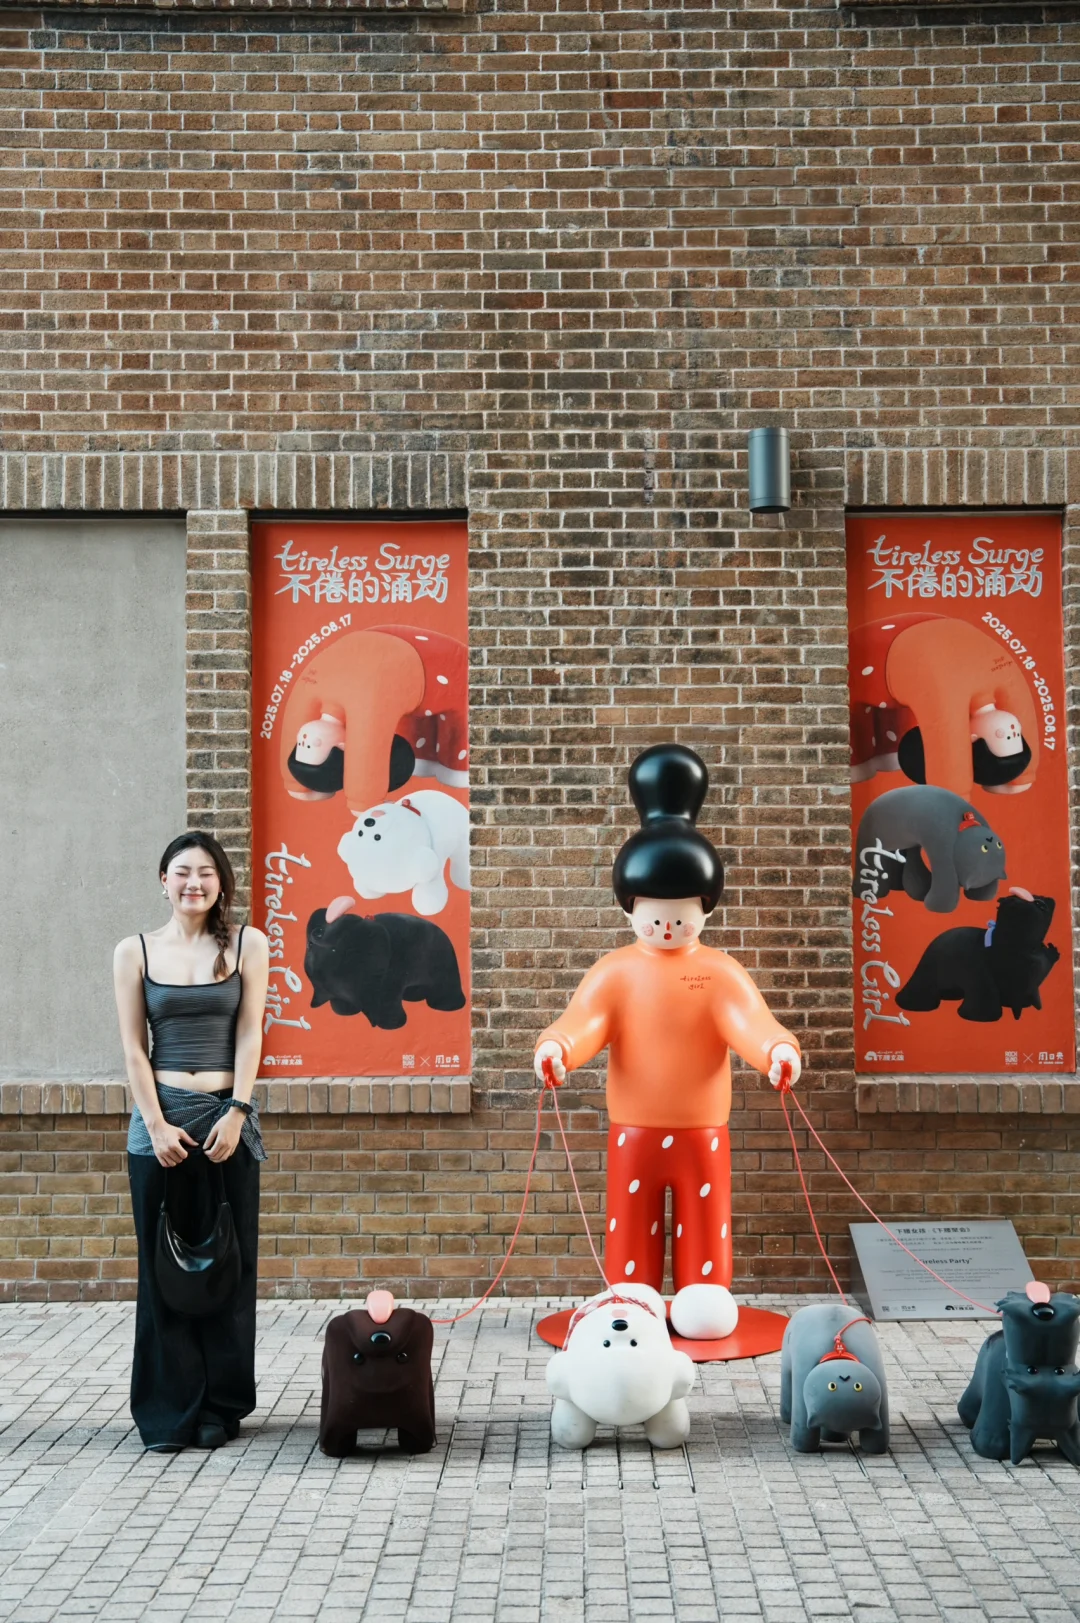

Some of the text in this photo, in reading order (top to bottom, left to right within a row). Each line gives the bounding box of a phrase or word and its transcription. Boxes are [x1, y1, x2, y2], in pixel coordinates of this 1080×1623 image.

[374, 543, 451, 579] Surge
[967, 536, 1045, 573] Surge
[274, 570, 449, 604] 不倦的涌动
[867, 565, 1043, 598] 不倦的涌动
